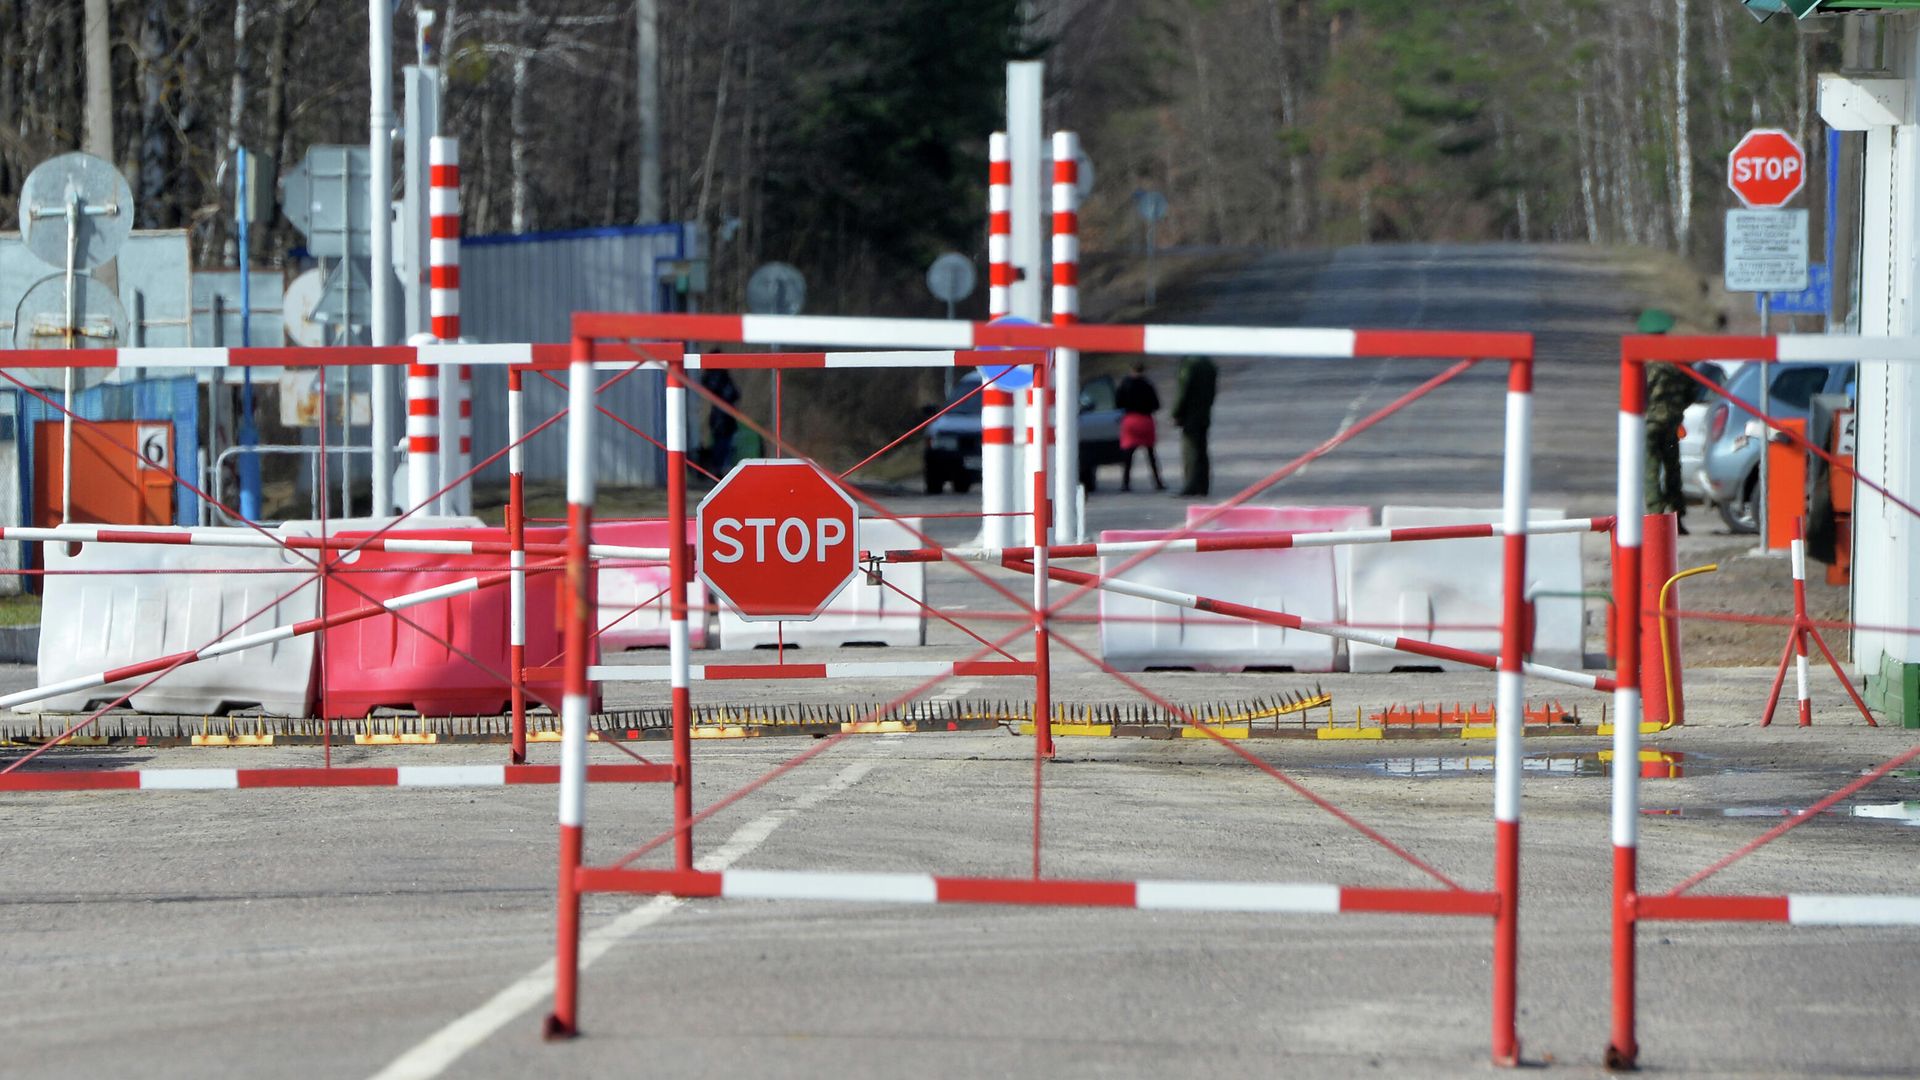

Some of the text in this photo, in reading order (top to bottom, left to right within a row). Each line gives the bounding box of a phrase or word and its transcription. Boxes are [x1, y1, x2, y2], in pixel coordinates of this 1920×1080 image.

[1735, 157, 1799, 183] STOP
[143, 430, 164, 463] 6
[712, 517, 846, 563] STOP
